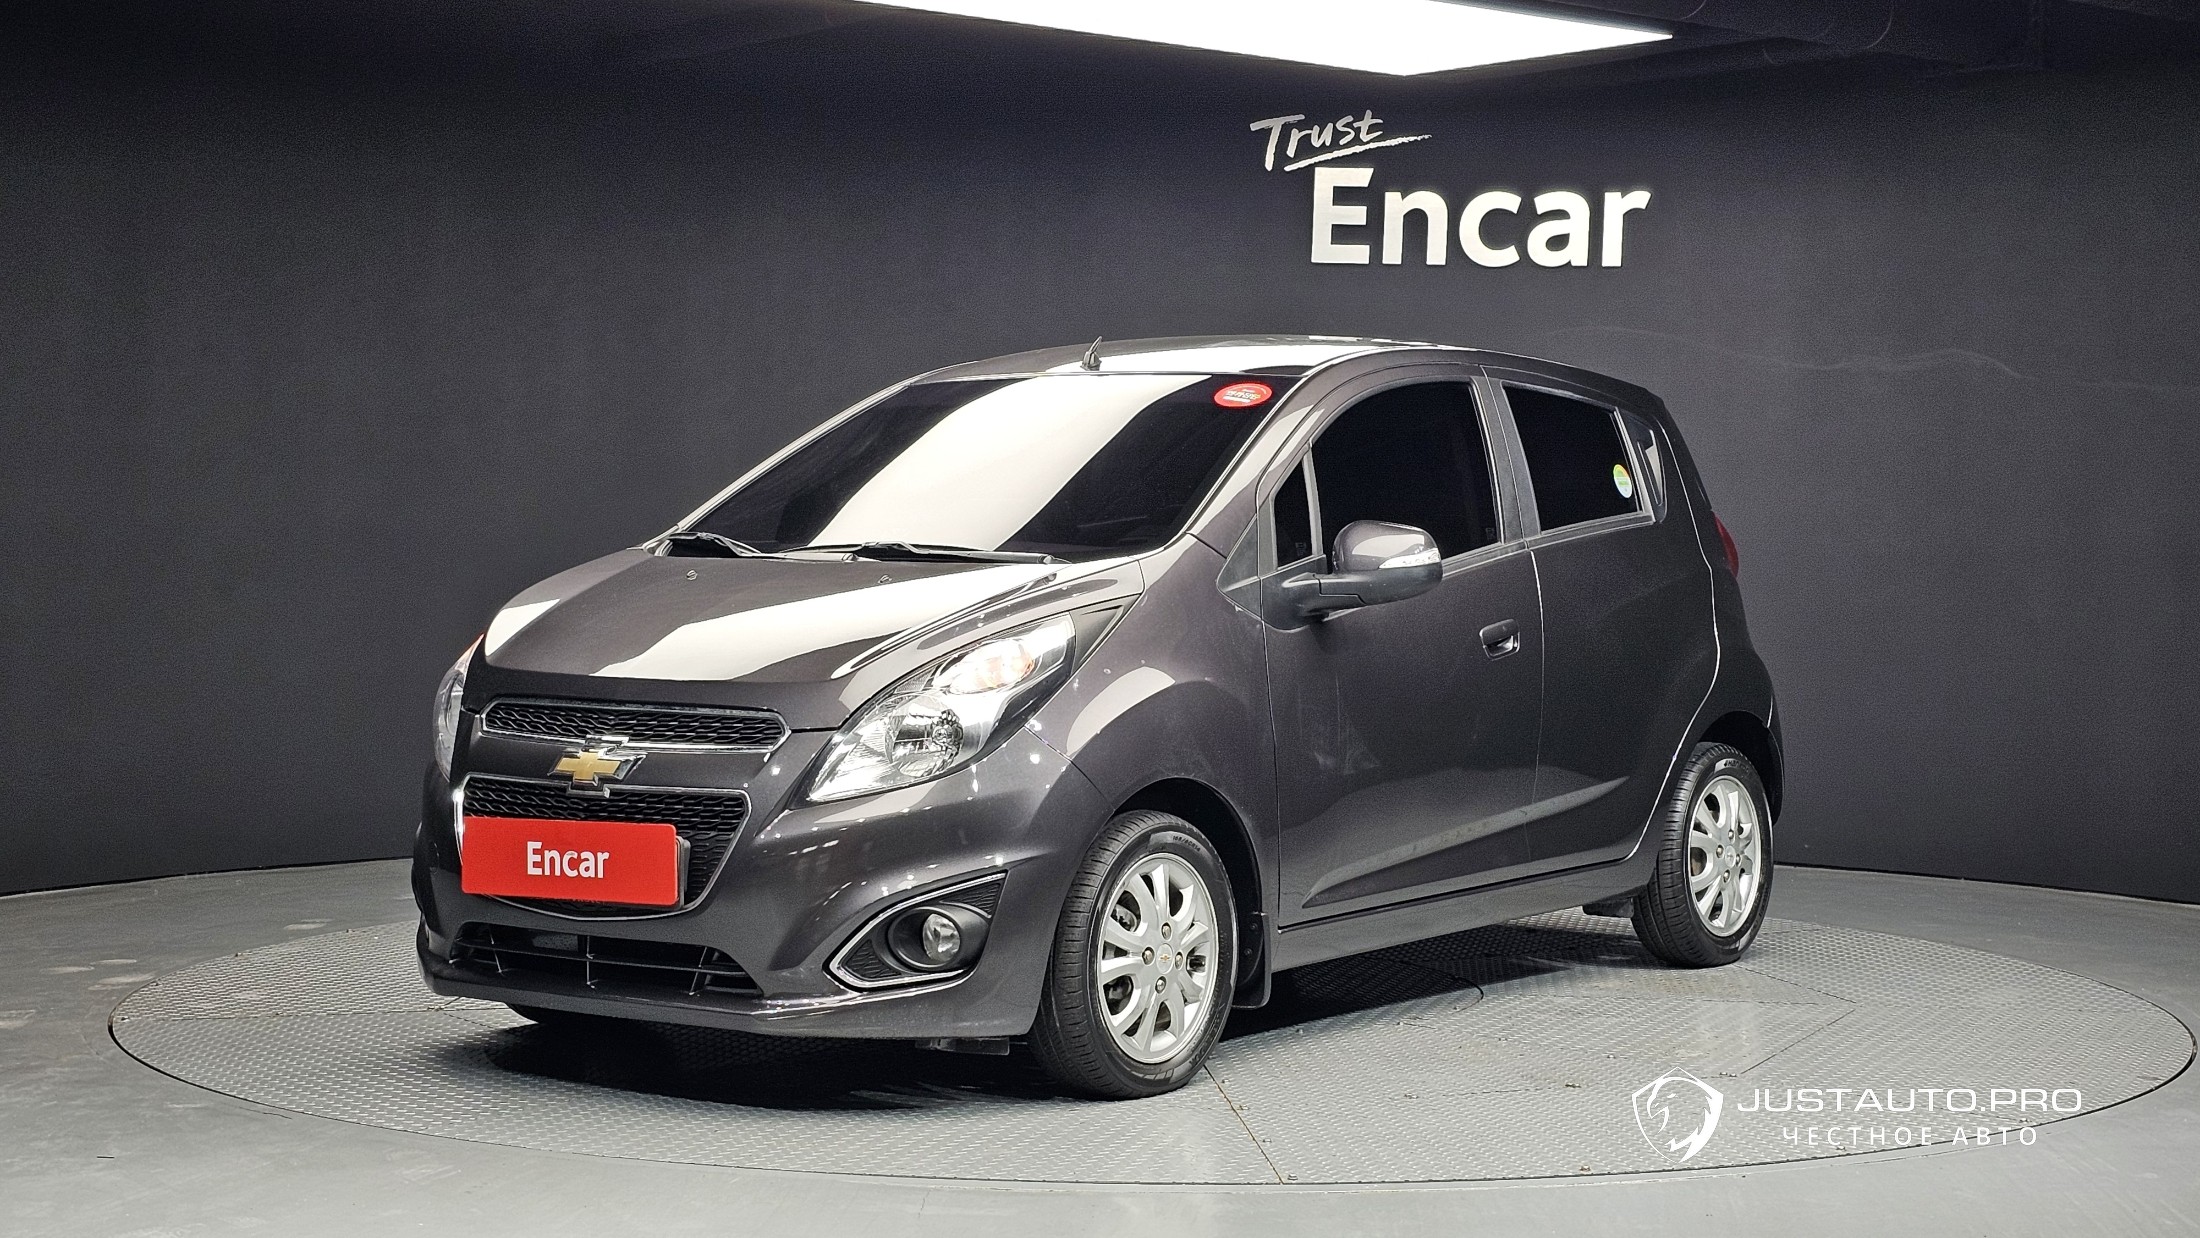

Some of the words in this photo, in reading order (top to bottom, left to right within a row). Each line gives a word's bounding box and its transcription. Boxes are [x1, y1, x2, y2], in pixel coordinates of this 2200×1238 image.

[1250, 109, 1384, 171] Trust
[1311, 167, 1653, 268] Encar
[527, 841, 609, 878] Encar
